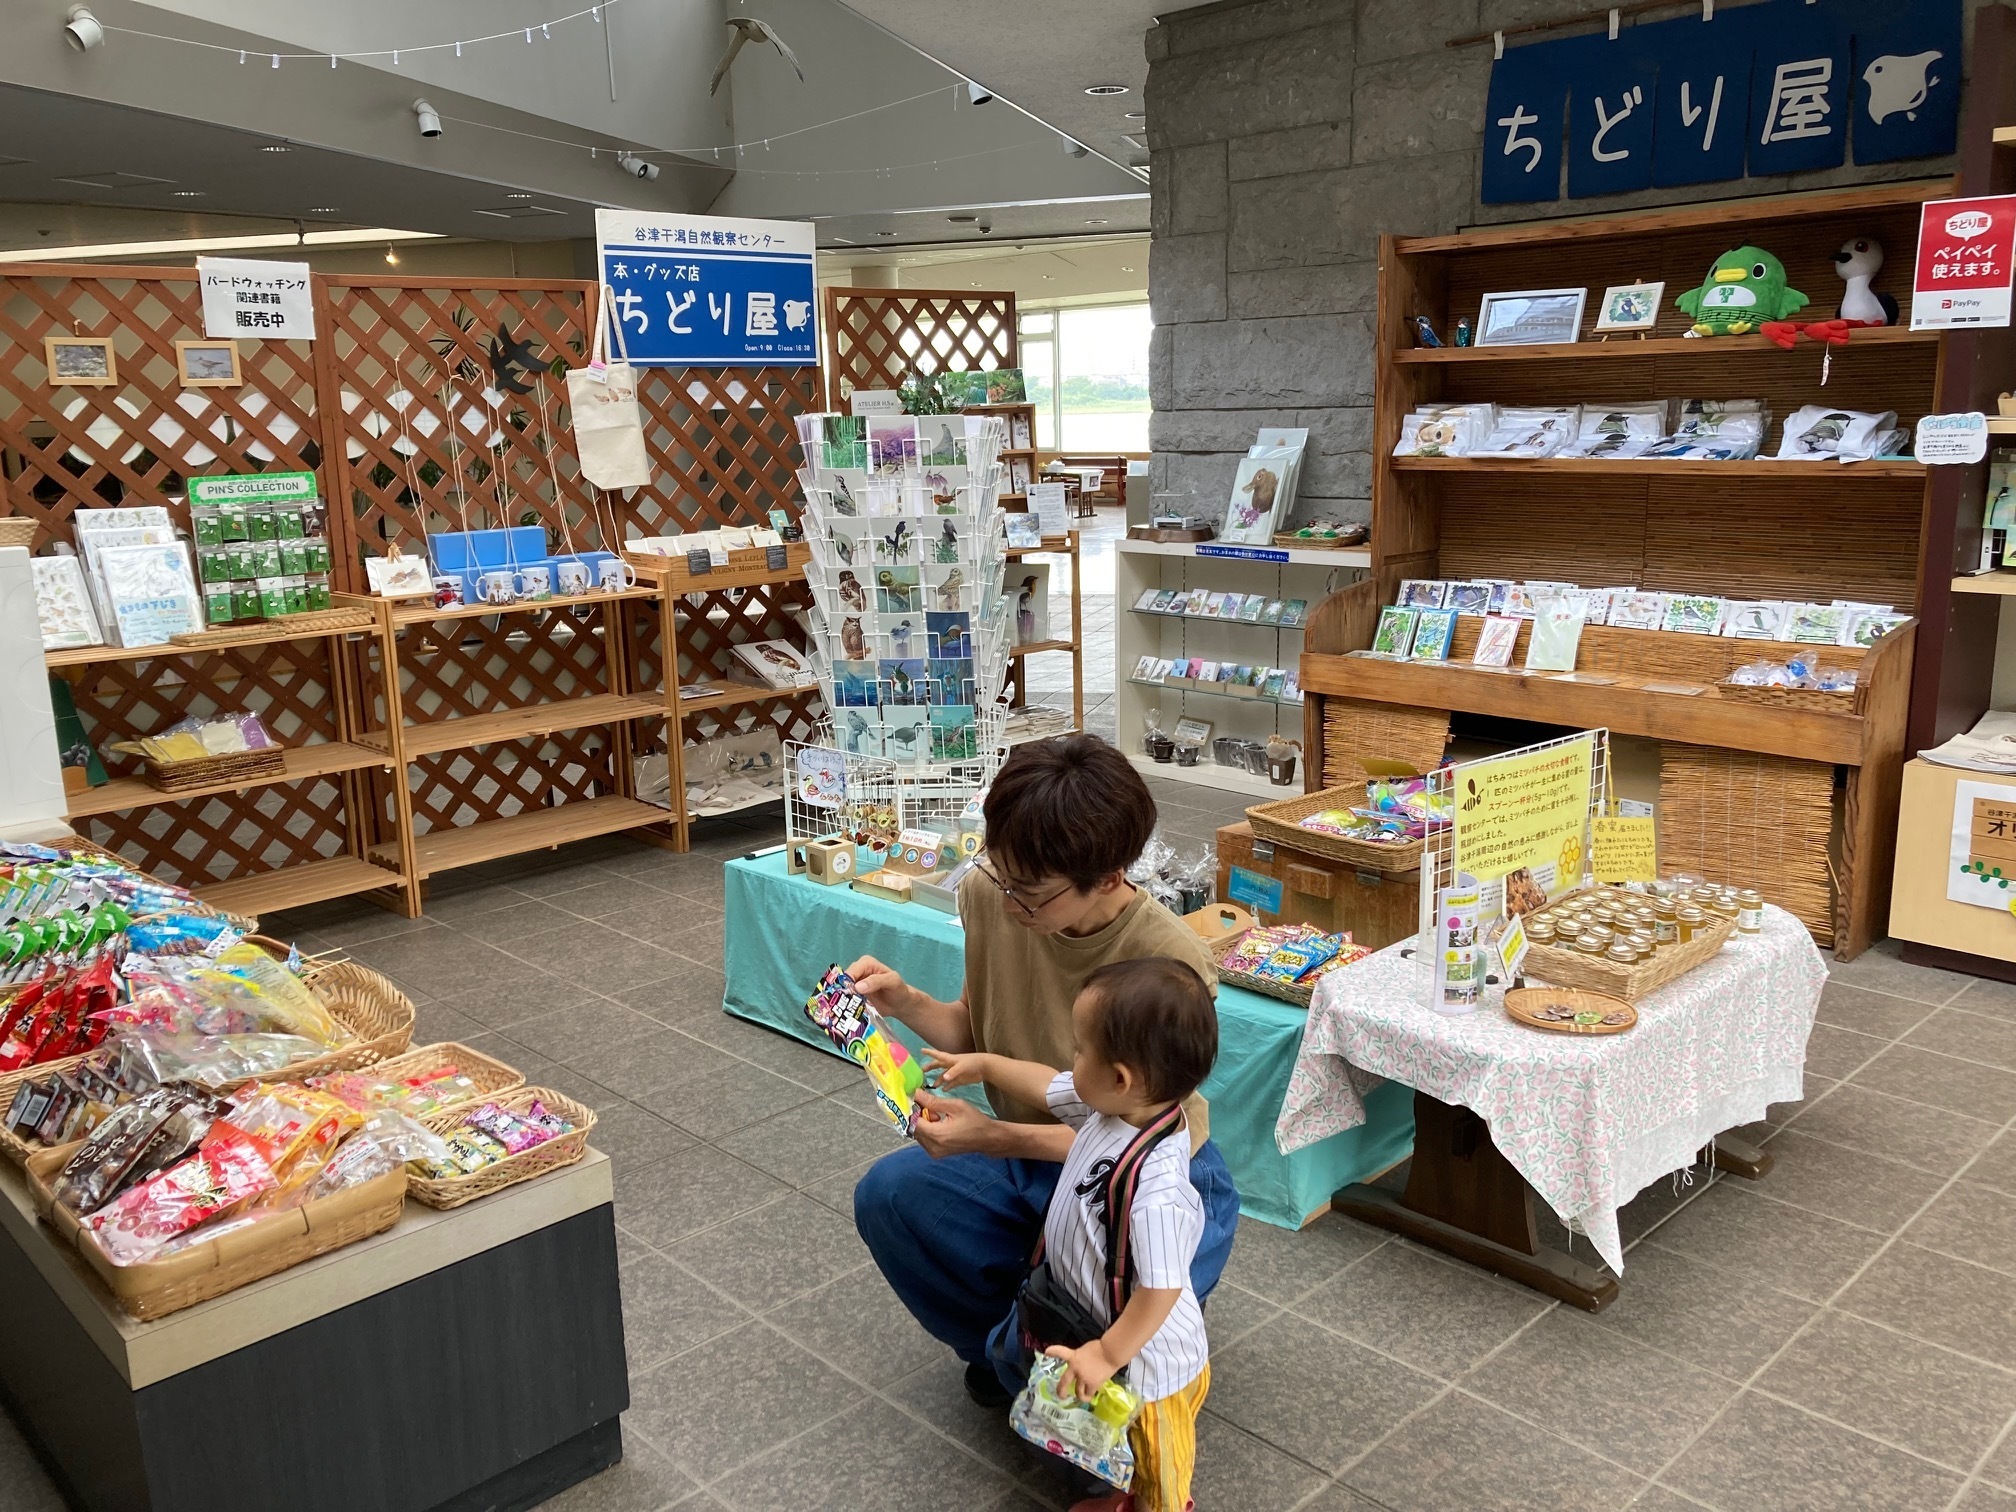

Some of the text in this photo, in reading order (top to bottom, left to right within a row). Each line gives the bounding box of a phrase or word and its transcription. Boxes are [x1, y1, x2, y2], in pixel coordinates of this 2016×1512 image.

[1497, 57, 1833, 173] ちどり屋
[1948, 216, 1988, 231] ちどり屋
[634, 227, 786, 248] 谷津干潟自然観察センター
[1933, 244, 1998, 261] ペイペイ
[613, 262, 700, 282] 本・グッズ店
[1931, 261, 2000, 280] 使えます。
[207, 276, 306, 290] バードウォッチング
[236, 291, 281, 304] 関連書籍
[1952, 299, 1981, 308] PayPay
[235, 310, 285, 328] 販売中
[615, 288, 779, 337] ちどり屋
[237, 481, 299, 493] COLLECTION
